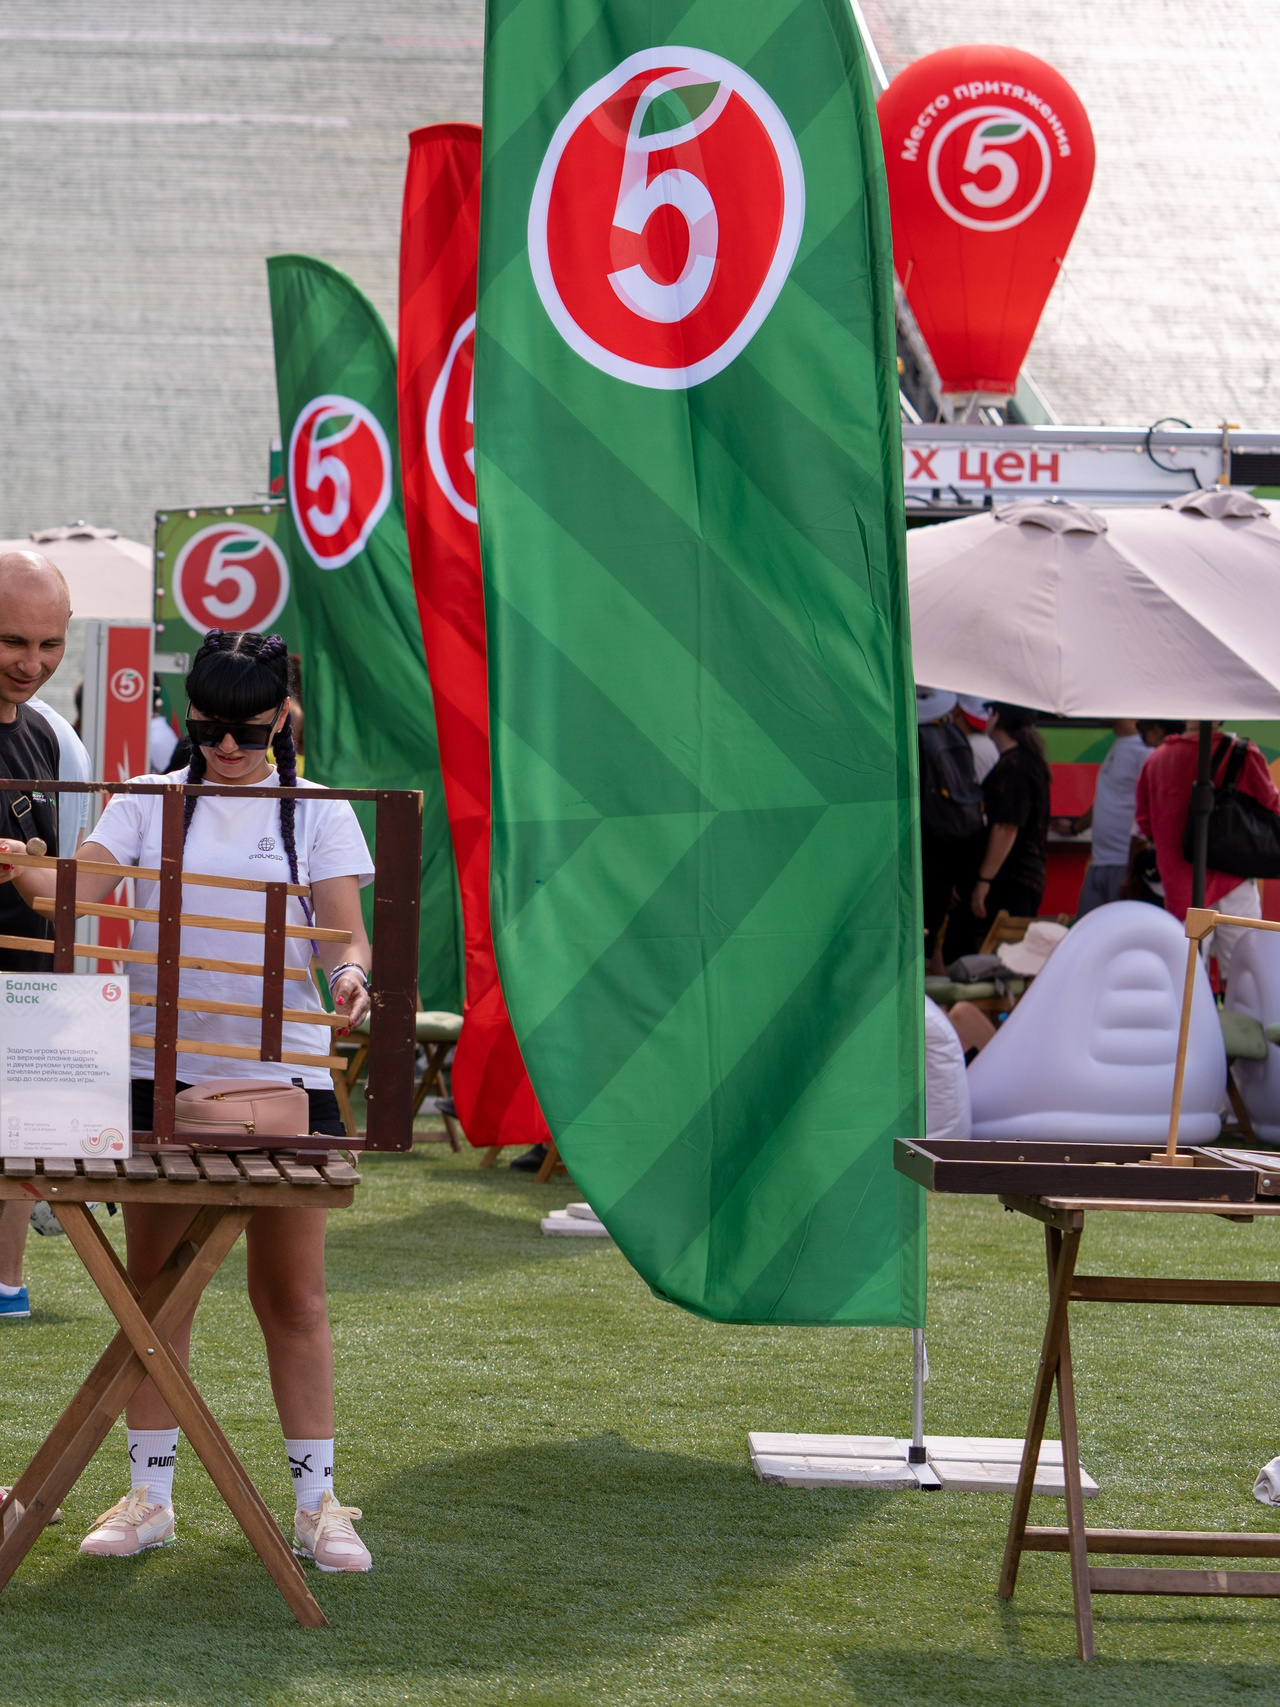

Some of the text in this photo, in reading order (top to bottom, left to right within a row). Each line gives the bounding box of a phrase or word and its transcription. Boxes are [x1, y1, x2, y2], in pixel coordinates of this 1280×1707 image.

[901, 81, 1071, 162] Место притяжения
[959, 117, 1027, 208] 5
[607, 72, 732, 324] 5
[306, 407, 357, 536] 5
[903, 449, 1060, 488] х цен
[201, 533, 266, 619] 5
[119, 671, 136, 696] 5
[6, 980, 58, 991] Баланс
[6, 992, 40, 1004] диск
[147, 1456, 175, 1468] PUM
[291, 1467, 302, 1478] MA
